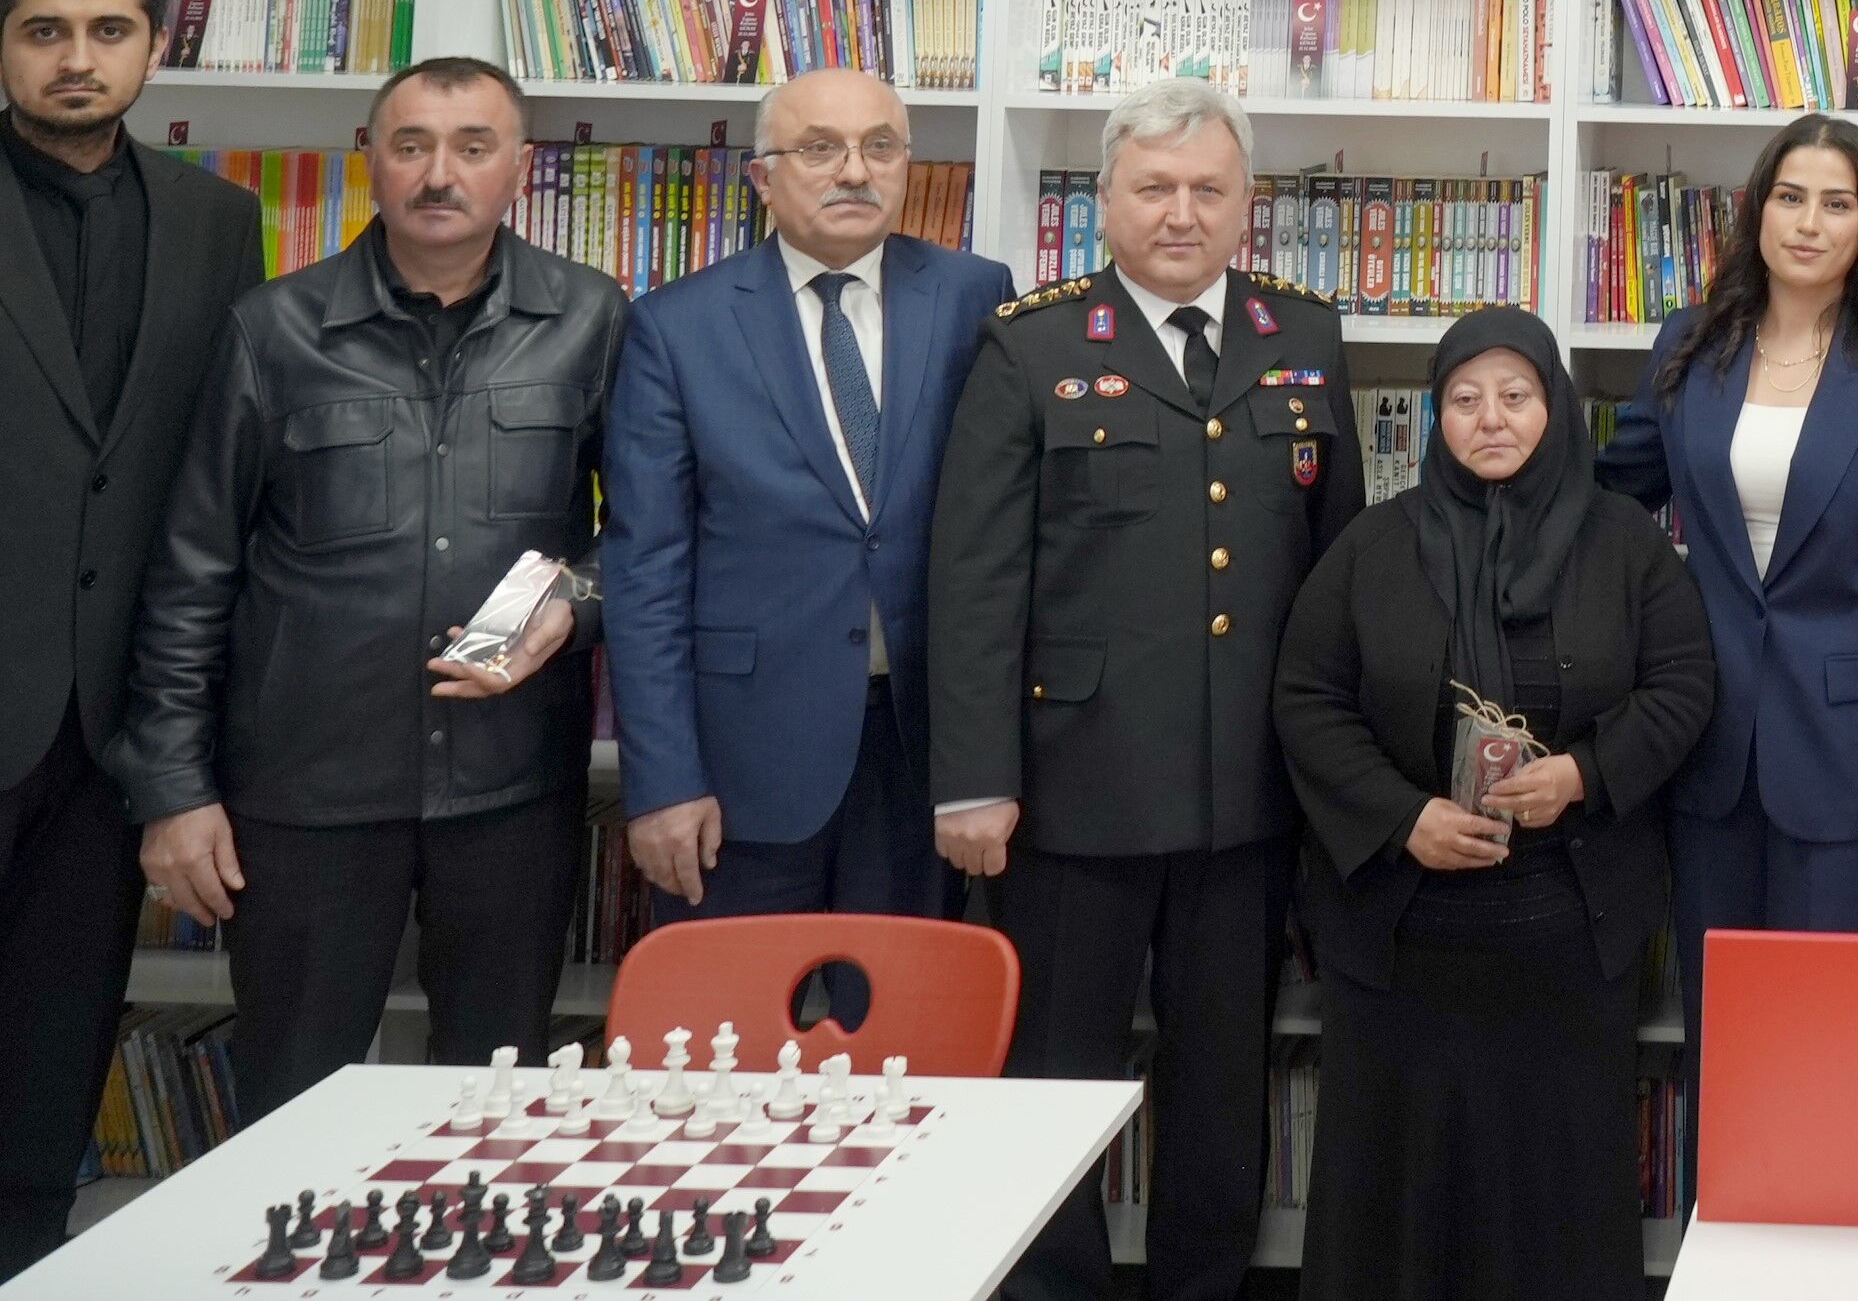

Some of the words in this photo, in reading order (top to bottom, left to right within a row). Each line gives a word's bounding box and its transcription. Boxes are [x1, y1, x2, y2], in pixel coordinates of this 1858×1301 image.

[1041, 204, 1050, 227] VERNE
[1051, 203, 1059, 226] JULES
[1070, 205, 1078, 227] VERNE
[1079, 204, 1088, 227] JULES
[1253, 205, 1261, 228] VERNE
[1262, 205, 1270, 228] JULES
[1276, 205, 1284, 227] VERNE
[1285, 205, 1293, 227] JULES
[1315, 206, 1324, 229] VERNE
[1324, 206, 1332, 228] JULES
[1368, 208, 1376, 231] VERNE
[1377, 208, 1385, 230] JULES
